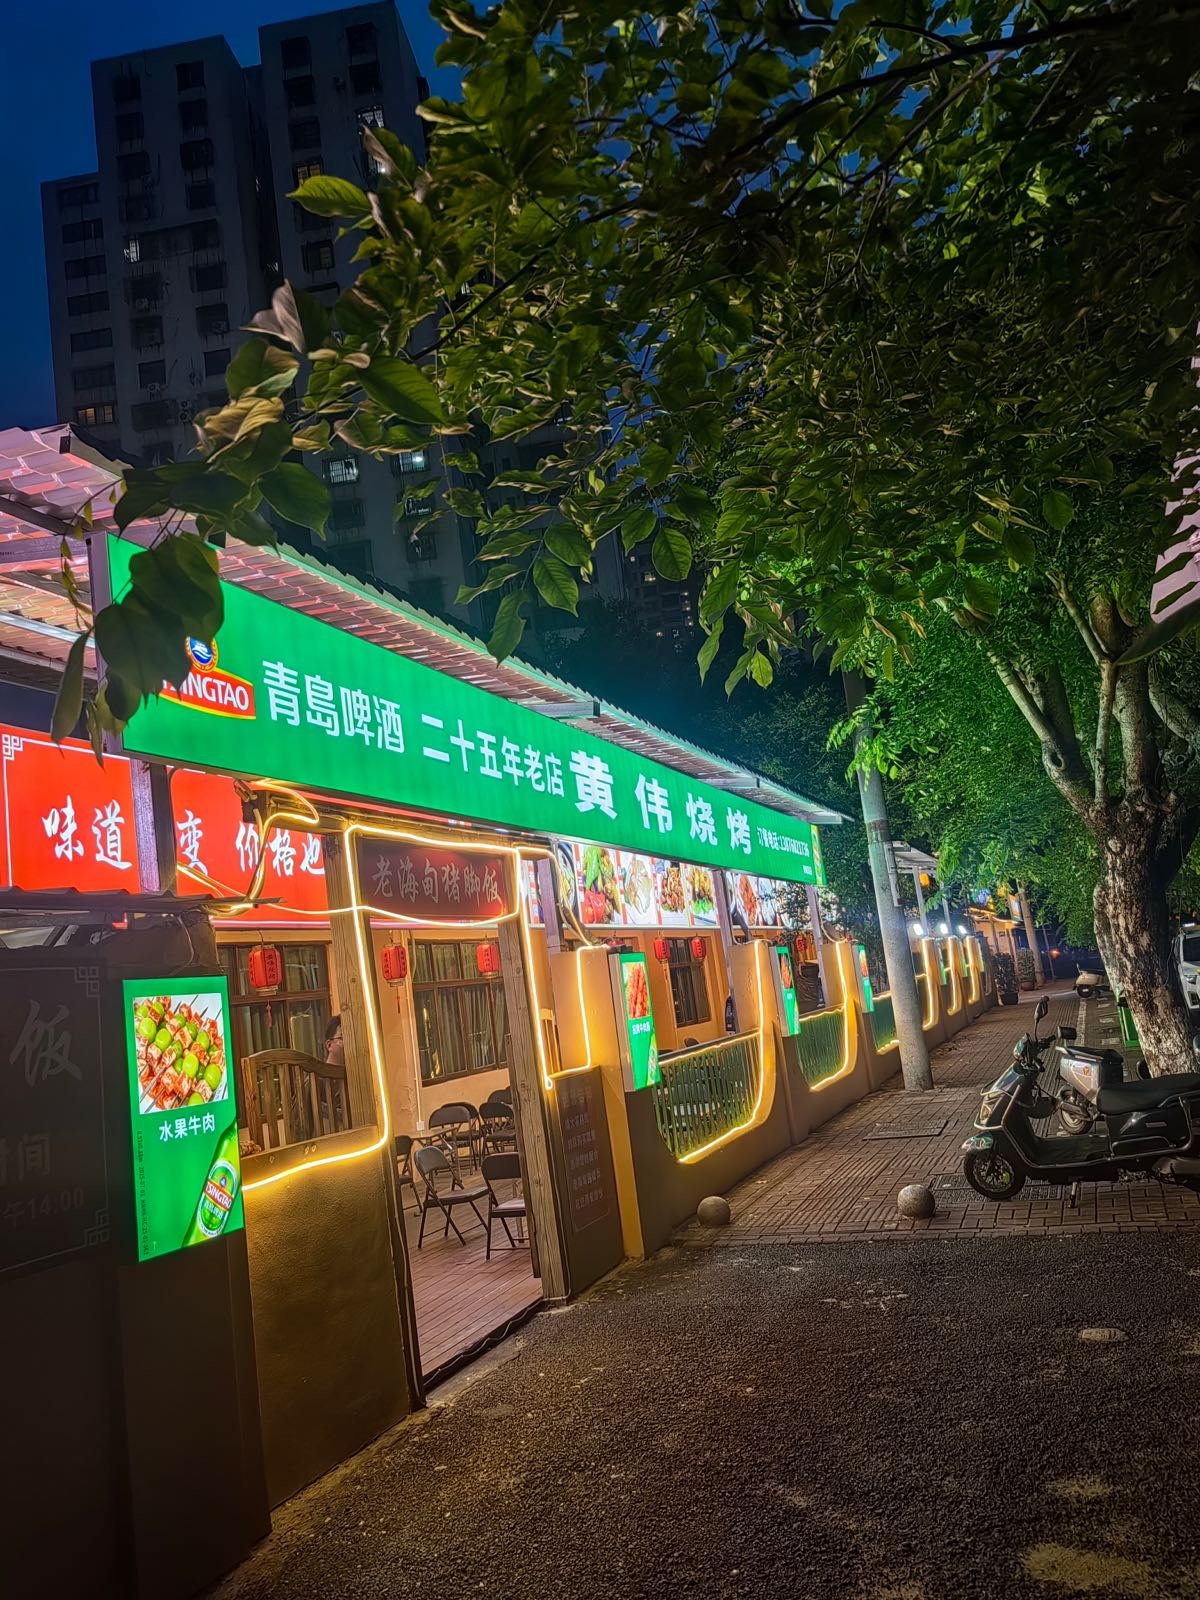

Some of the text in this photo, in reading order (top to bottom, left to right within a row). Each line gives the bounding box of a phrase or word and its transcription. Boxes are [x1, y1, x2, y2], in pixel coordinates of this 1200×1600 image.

[421, 713, 565, 798] 二十五年老店
[569, 750, 752, 855] 黄伟烧烤
[158, 1112, 216, 1142] 水果牛肉
